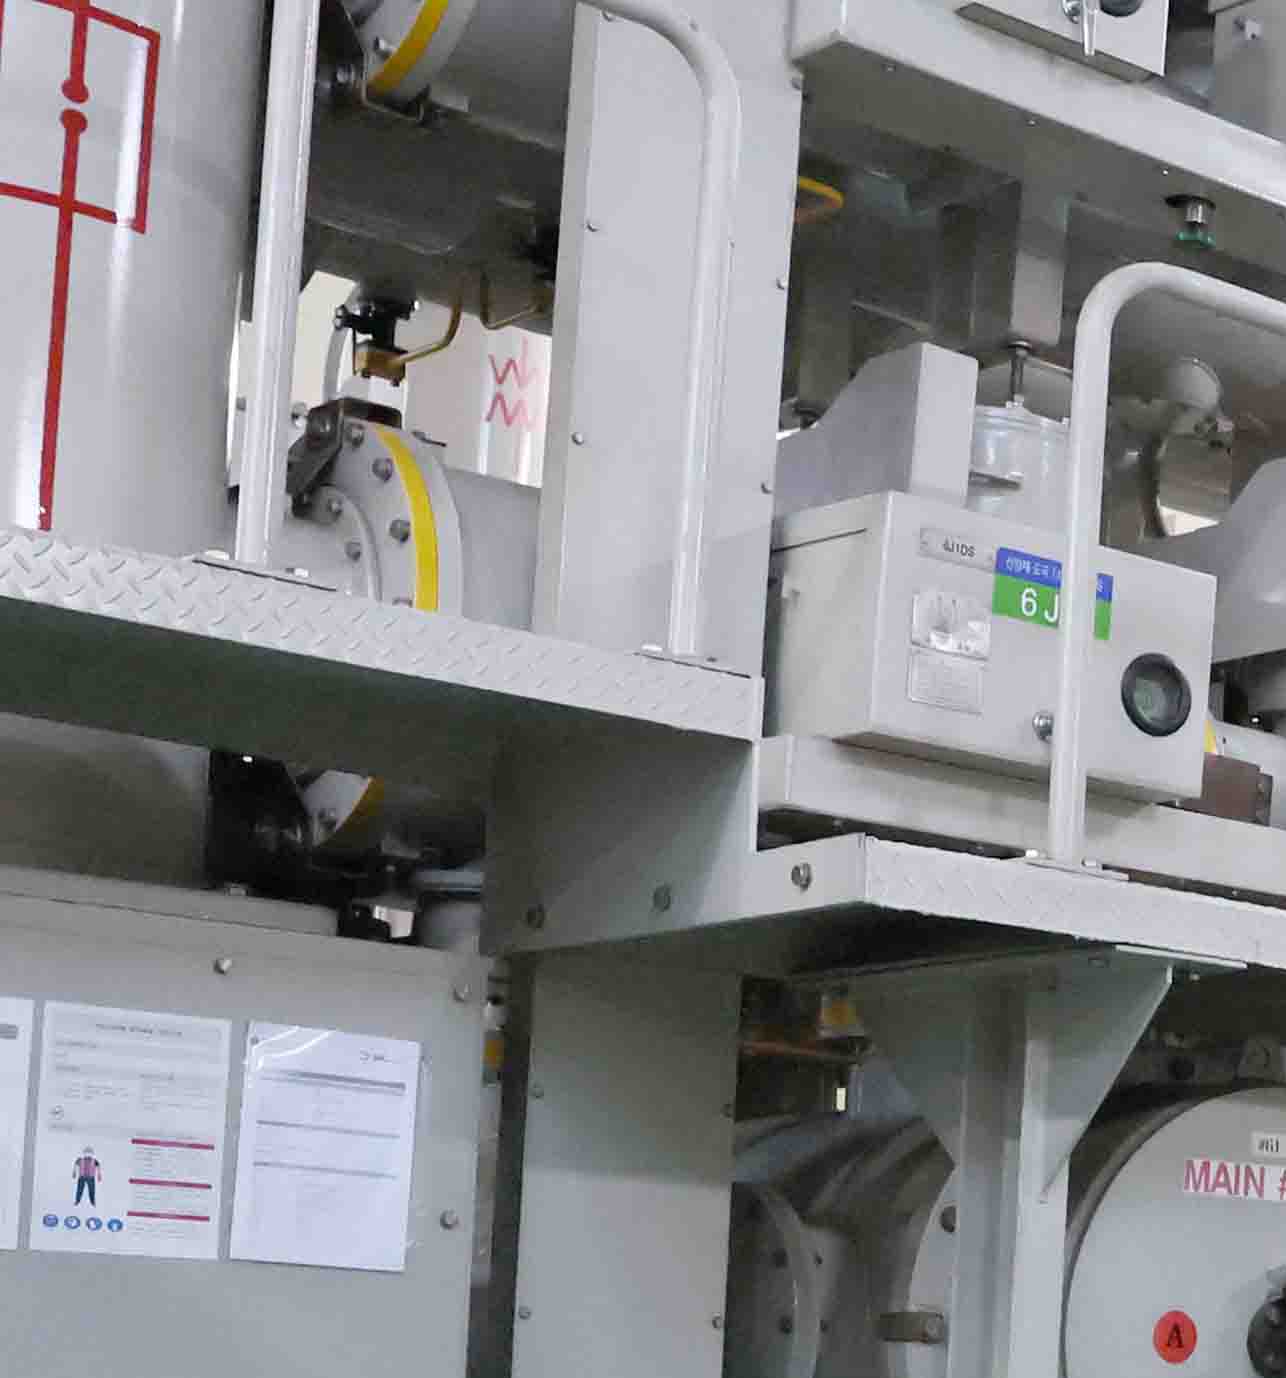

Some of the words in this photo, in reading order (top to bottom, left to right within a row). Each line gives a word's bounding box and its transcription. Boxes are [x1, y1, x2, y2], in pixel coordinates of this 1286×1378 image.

[1021, 586, 1060, 623] 6J
[1184, 1159, 1265, 1198] MAIN
[1166, 1322, 1185, 1349] A
